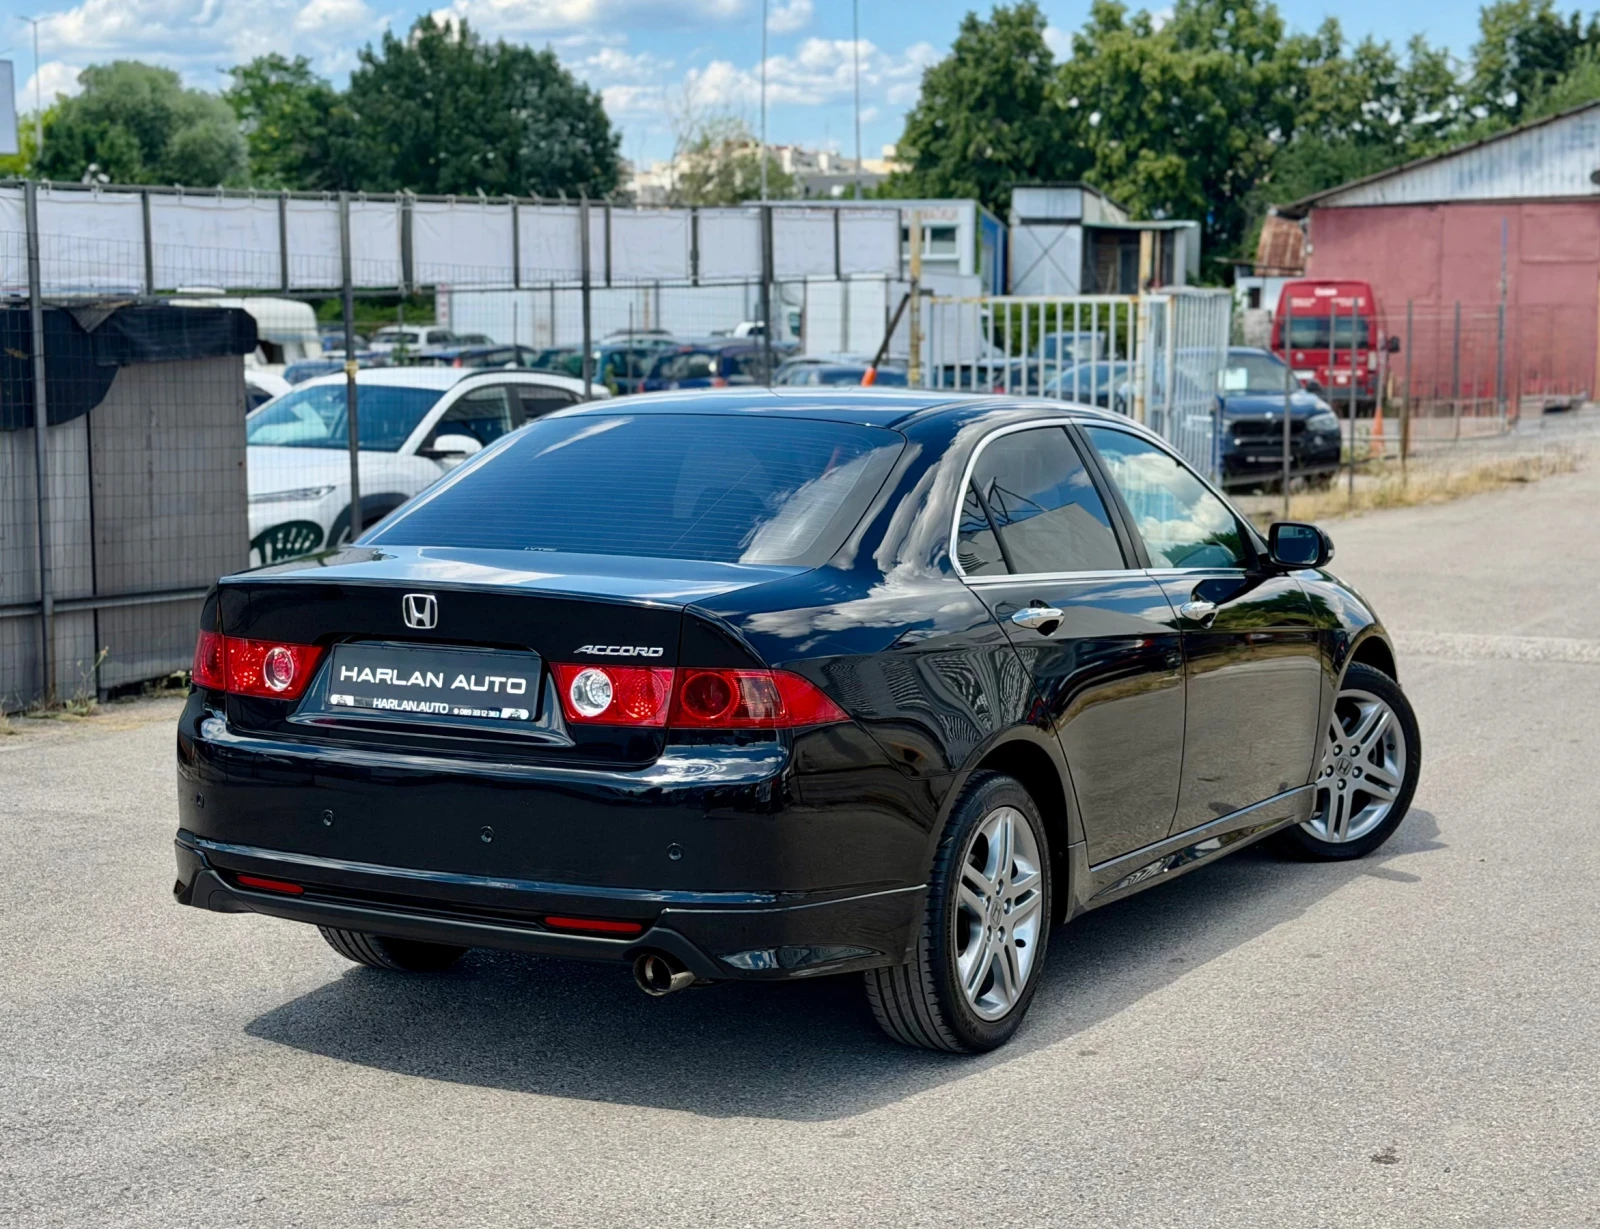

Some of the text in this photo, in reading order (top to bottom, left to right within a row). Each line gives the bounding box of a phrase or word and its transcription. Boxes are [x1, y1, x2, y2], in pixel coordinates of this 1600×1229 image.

[573, 645, 664, 657] ACCORD
[340, 666, 527, 695] HARLAN AUTO
[373, 697, 450, 714] HARLAN.AUTO
